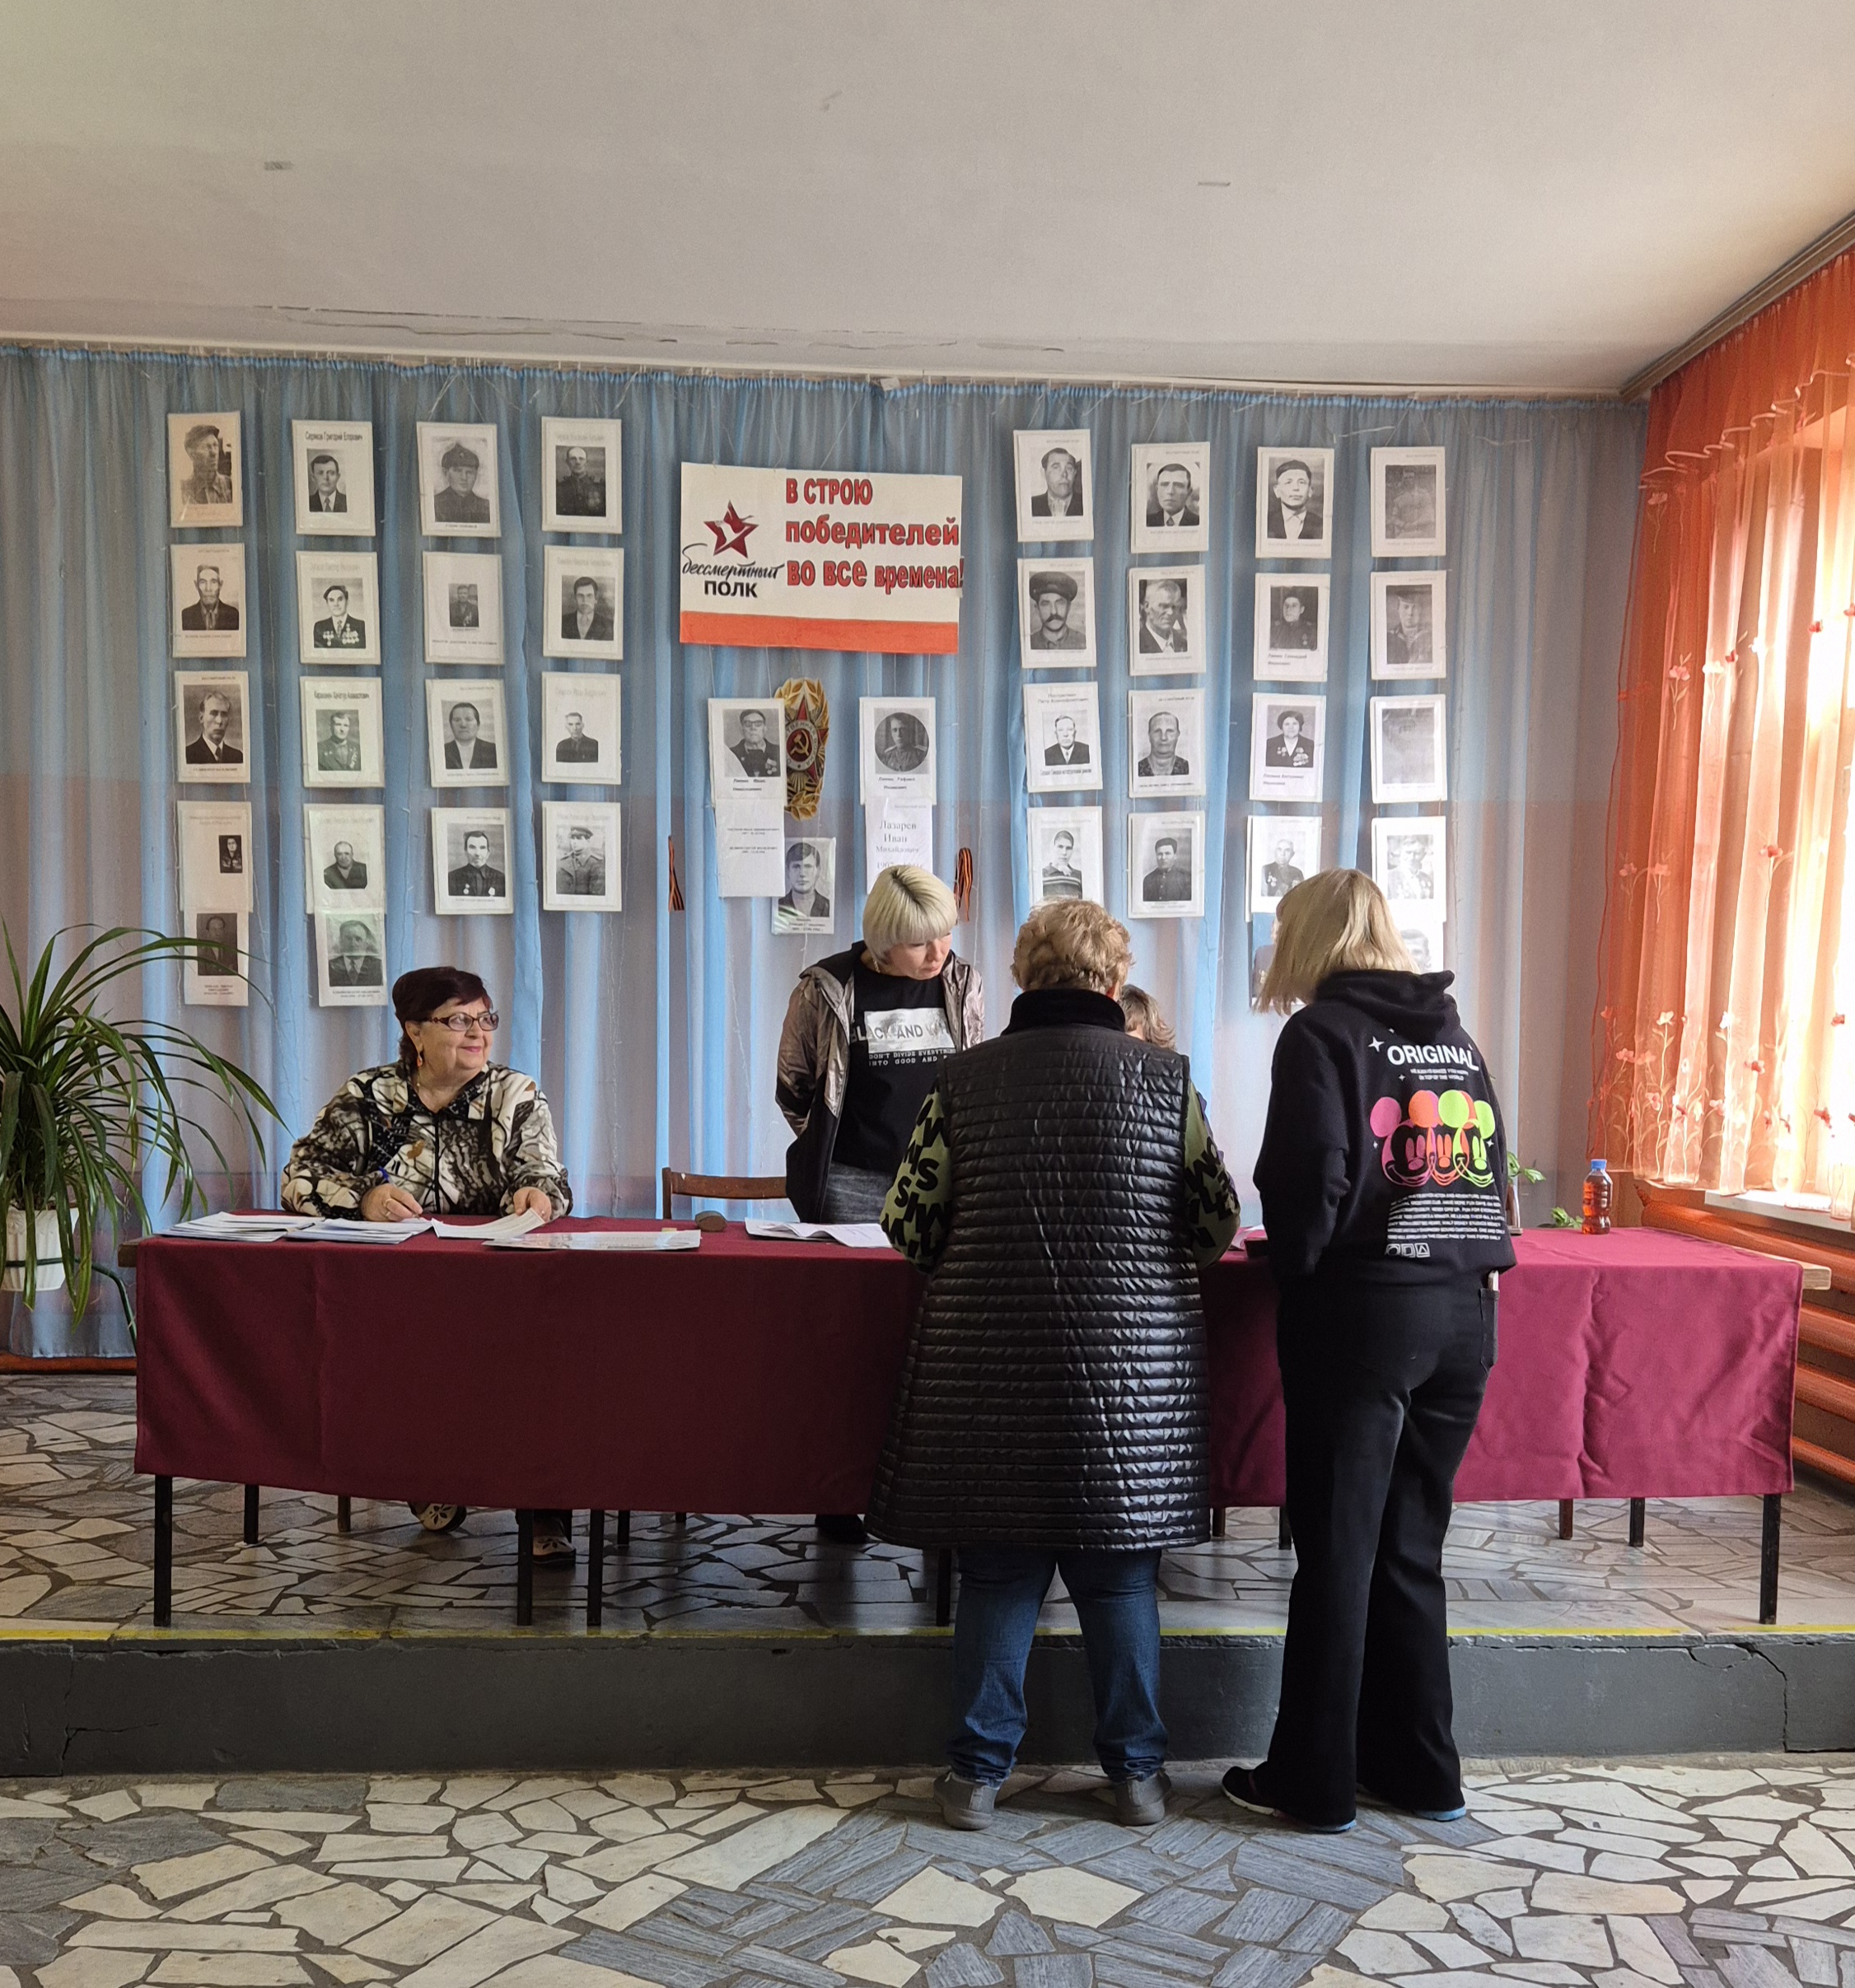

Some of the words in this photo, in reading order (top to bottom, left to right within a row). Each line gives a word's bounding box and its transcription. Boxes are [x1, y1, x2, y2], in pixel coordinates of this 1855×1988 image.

[786, 478, 798, 504] В
[803, 478, 873, 506] СТРОЮ
[786, 514, 959, 549] победителей
[682, 543, 785, 581] бессмертный
[704, 581, 758, 598] ПОЛК
[787, 559, 815, 586] во
[823, 559, 867, 587] все
[874, 558, 965, 595] времена!
[880, 820, 917, 832] Лазарев
[884, 833, 908, 842] Иван
[897, 1024, 923, 1039] AND
[1387, 1044, 1479, 1071] ORIGINAL
